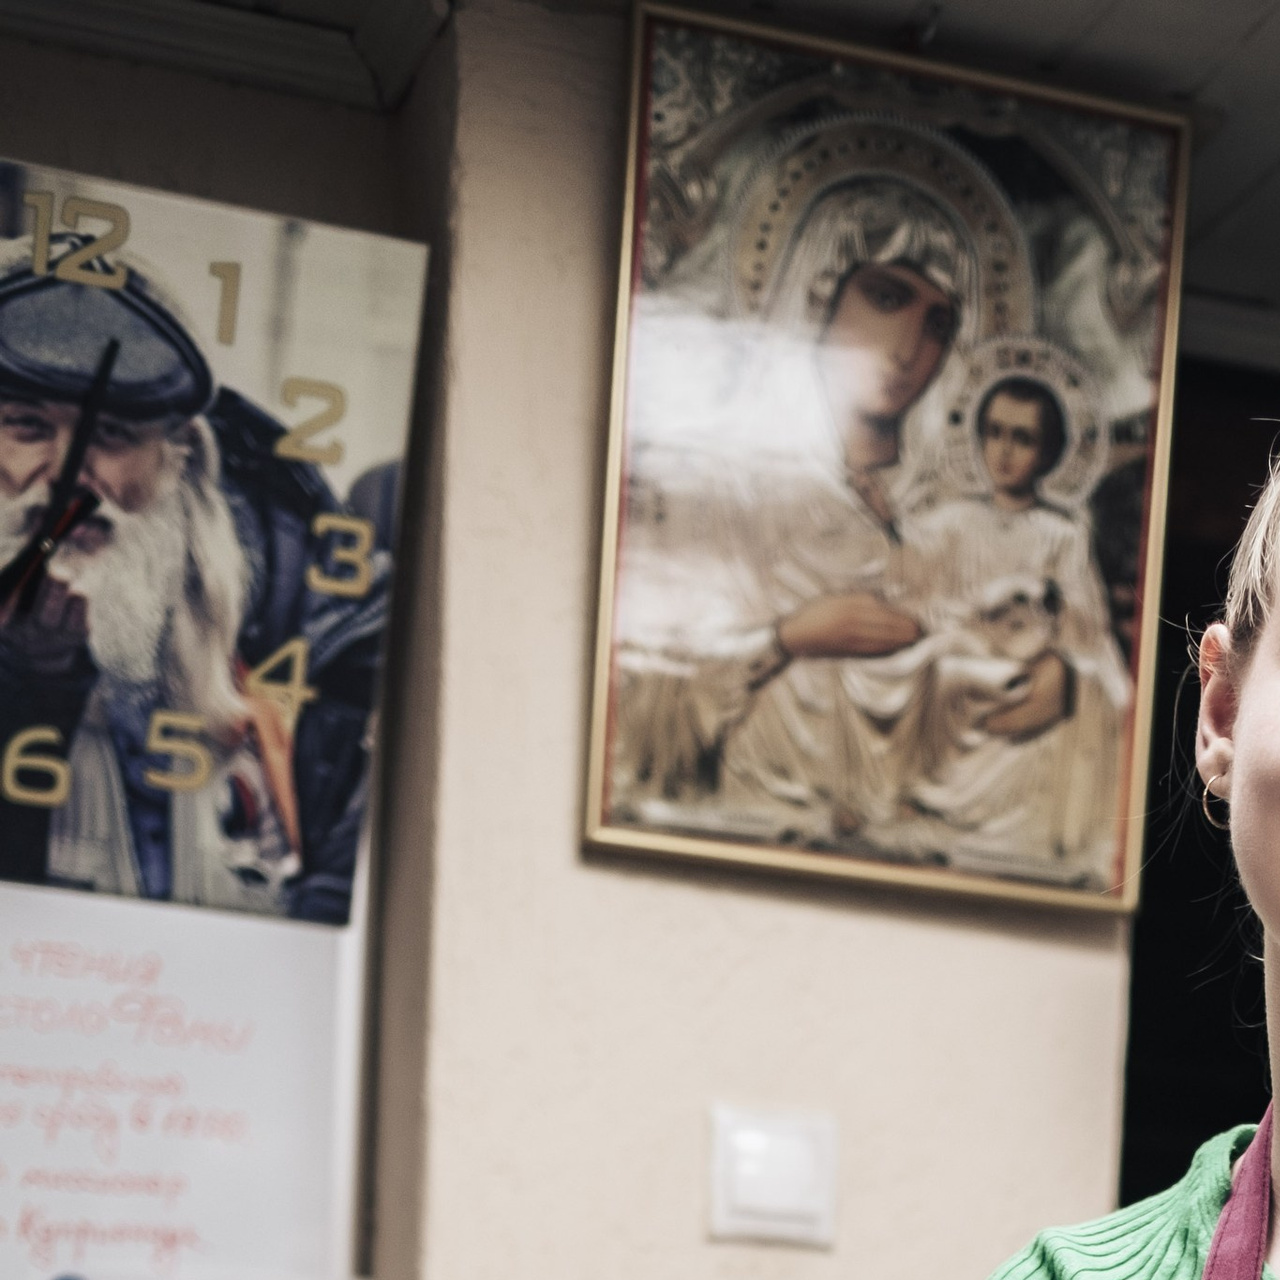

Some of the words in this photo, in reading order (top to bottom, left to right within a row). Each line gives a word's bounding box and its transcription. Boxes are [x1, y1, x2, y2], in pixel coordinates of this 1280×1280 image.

[23, 190, 131, 290] 12
[209, 262, 242, 346] 1
[274, 377, 348, 465] 2
[306, 513, 375, 599] 3
[246, 636, 319, 728] 4
[2, 726, 73, 806] 6
[144, 710, 214, 791] 5
